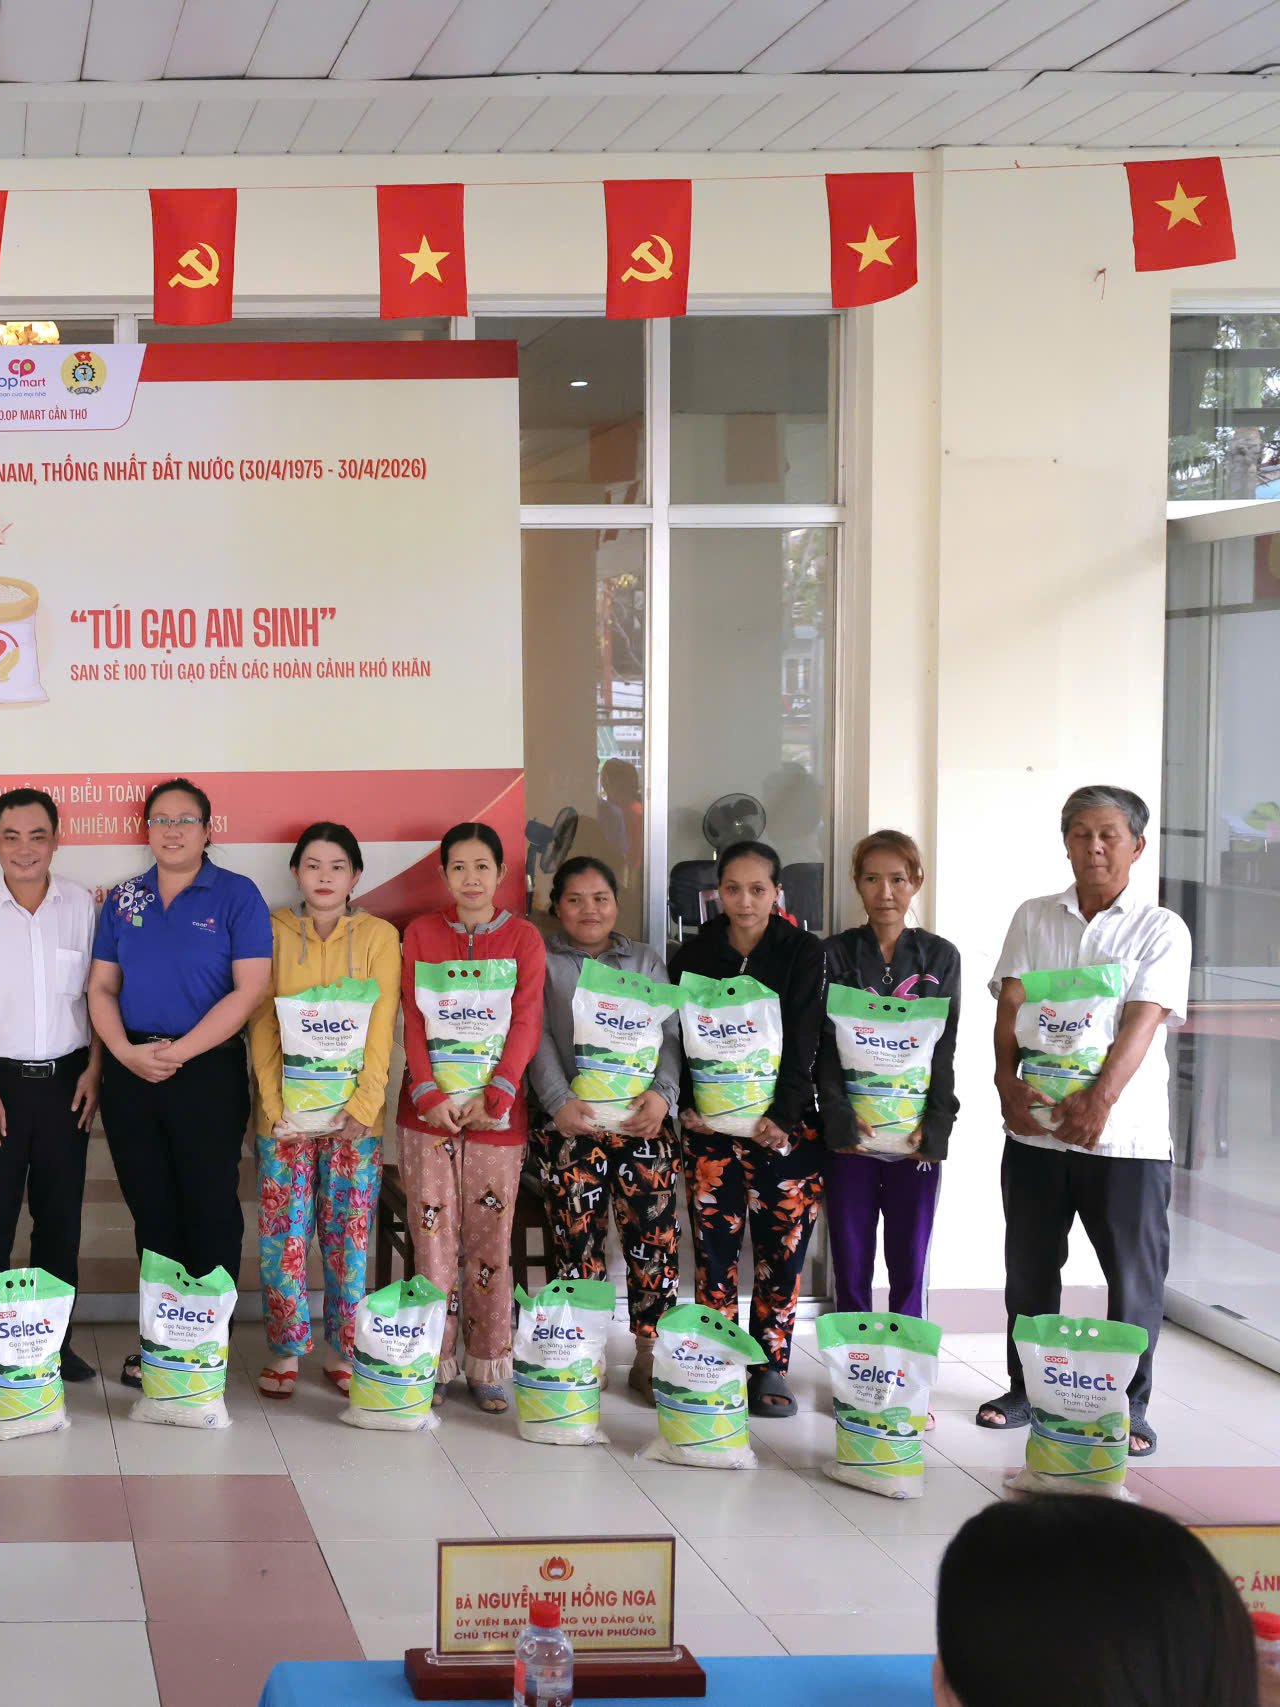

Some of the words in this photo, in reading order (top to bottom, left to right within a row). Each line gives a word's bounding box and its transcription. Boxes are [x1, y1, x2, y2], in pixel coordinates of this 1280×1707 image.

[20, 410, 46, 420] MART
[48, 404, 67, 420] CẦN
[70, 408, 88, 420] THƠ
[42, 453, 98, 482] THỐNG
[104, 453, 147, 481] NHẤT
[152, 453, 182, 480] ĐẤT
[188, 456, 234, 480] NƯỚC
[239, 458, 322, 481] (30/4/1975
[338, 458, 427, 480] 30/4/2026)
[141, 608, 197, 654] GẠO
[205, 608, 243, 647] AN
[70, 664, 99, 681] SAN
[103, 659, 120, 681] SẺ
[124, 664, 146, 681] 100
[151, 660, 173, 680] TÚI
[177, 663, 205, 684] GẠO
[210, 656, 237, 680] ĐẾN
[242, 659, 269, 679] CÁC
[273, 659, 312, 679] HOÀN
[316, 658, 354, 678] CẢNH
[359, 658, 387, 678] KHÓ
[392, 658, 431, 678] KHĂN
[71, 777, 102, 803] BIỂU
[107, 781, 146, 803] TOÀN
[70, 813, 118, 838] NHIỆM
[123, 813, 142, 834] KỲ
[439, 1008, 496, 1020] Select
[595, 1012, 653, 1030] Select
[301, 1018, 358, 1033] Select
[697, 1020, 757, 1038] Select
[855, 1032, 920, 1050] Select
[156, 1303, 214, 1323] Select
[372, 1317, 426, 1338] Select
[1045, 1356, 1068, 1364] COOP
[848, 1364, 905, 1387] Select
[1044, 1366, 1117, 1391] Select
[456, 1593, 472, 1609] BÀ
[478, 1585, 539, 1609] NGUYỄN
[571, 1583, 618, 1607] HỒNG
[623, 1590, 656, 1607] NGA
[475, 1616, 499, 1627] VIÊN
[504, 1618, 526, 1626] BAN
[454, 1629, 479, 1640] CHỦ
[482, 1631, 508, 1641] TỊCH
[607, 1626, 657, 1638] PHƯỜNG
